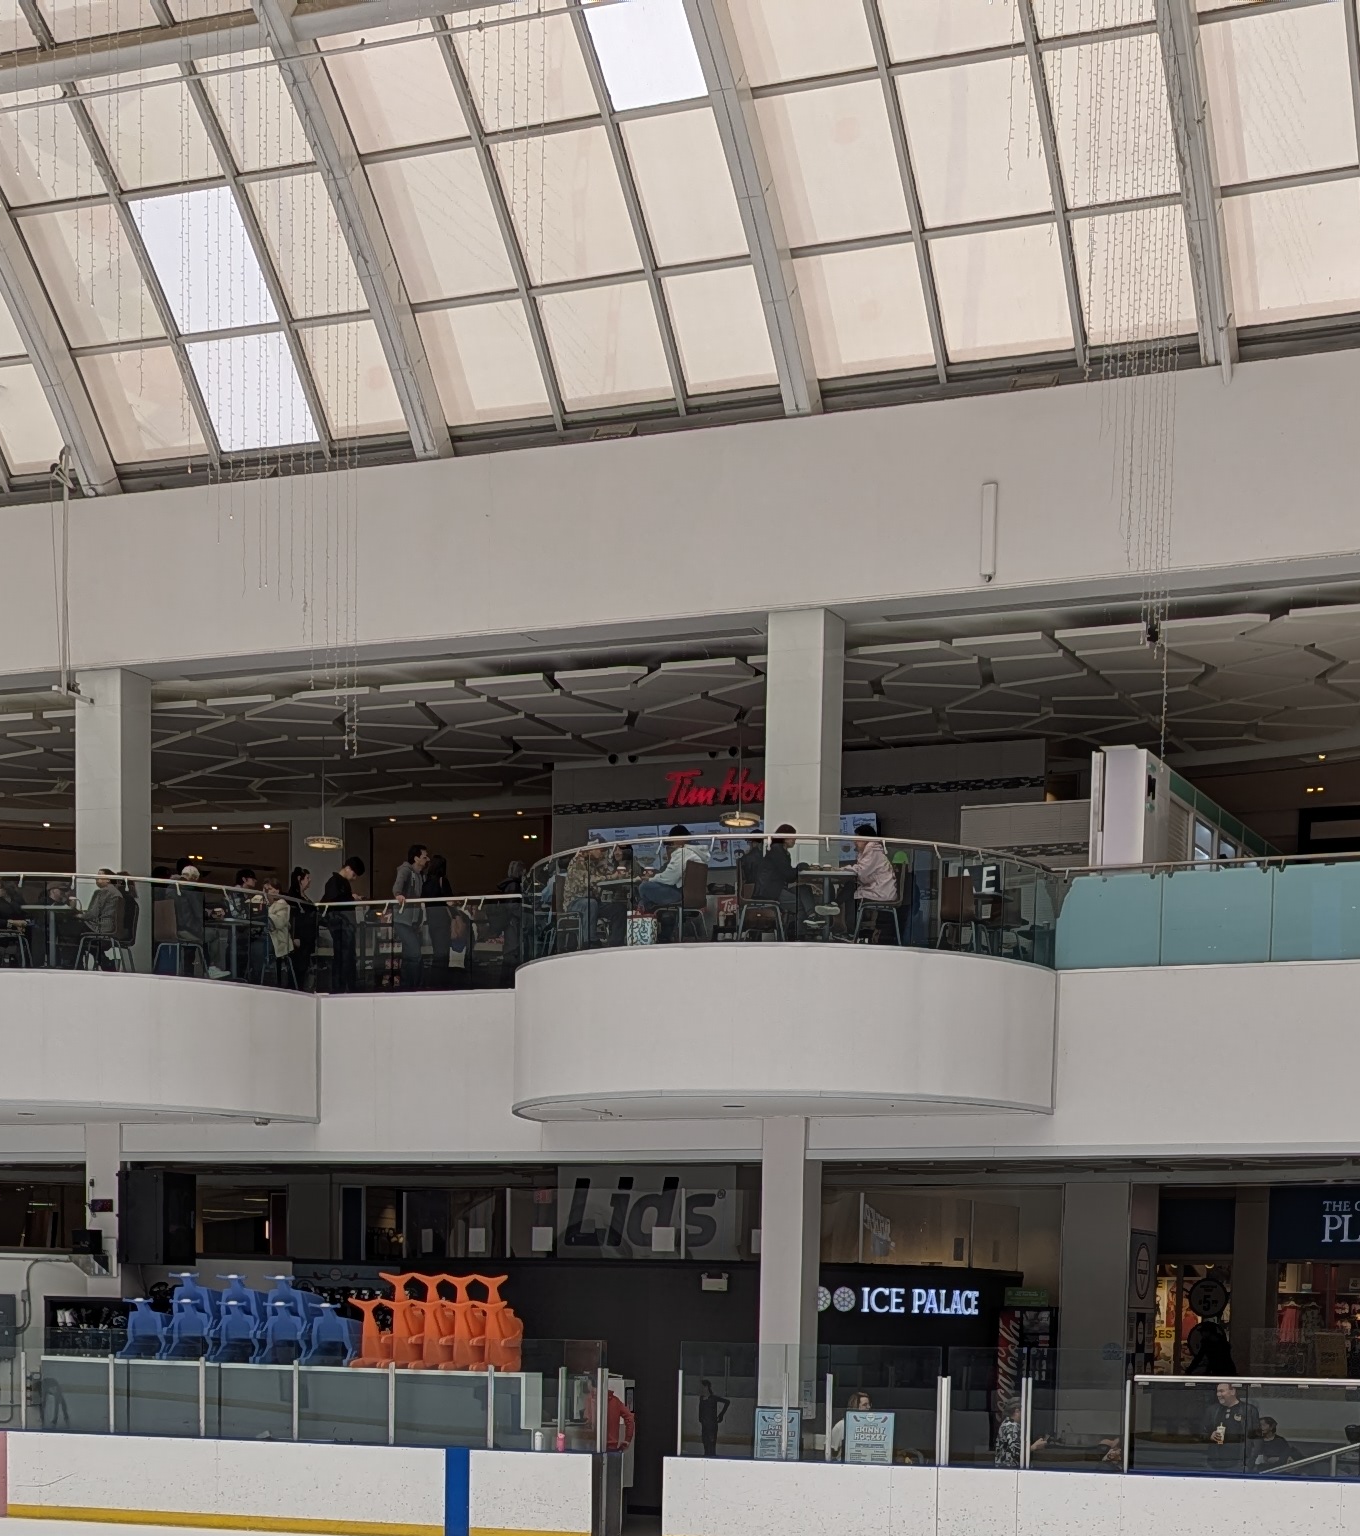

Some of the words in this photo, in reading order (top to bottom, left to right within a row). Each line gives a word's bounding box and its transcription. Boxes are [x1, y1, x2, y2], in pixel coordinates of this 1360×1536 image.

[665, 769, 719, 807] Tim
[565, 1177, 717, 1247] Lids
[1323, 1200, 1351, 1212] THE
[860, 1287, 905, 1313] ICE
[911, 1289, 979, 1315] PALACE
[854, 1433, 887, 1441] HOCKEY
